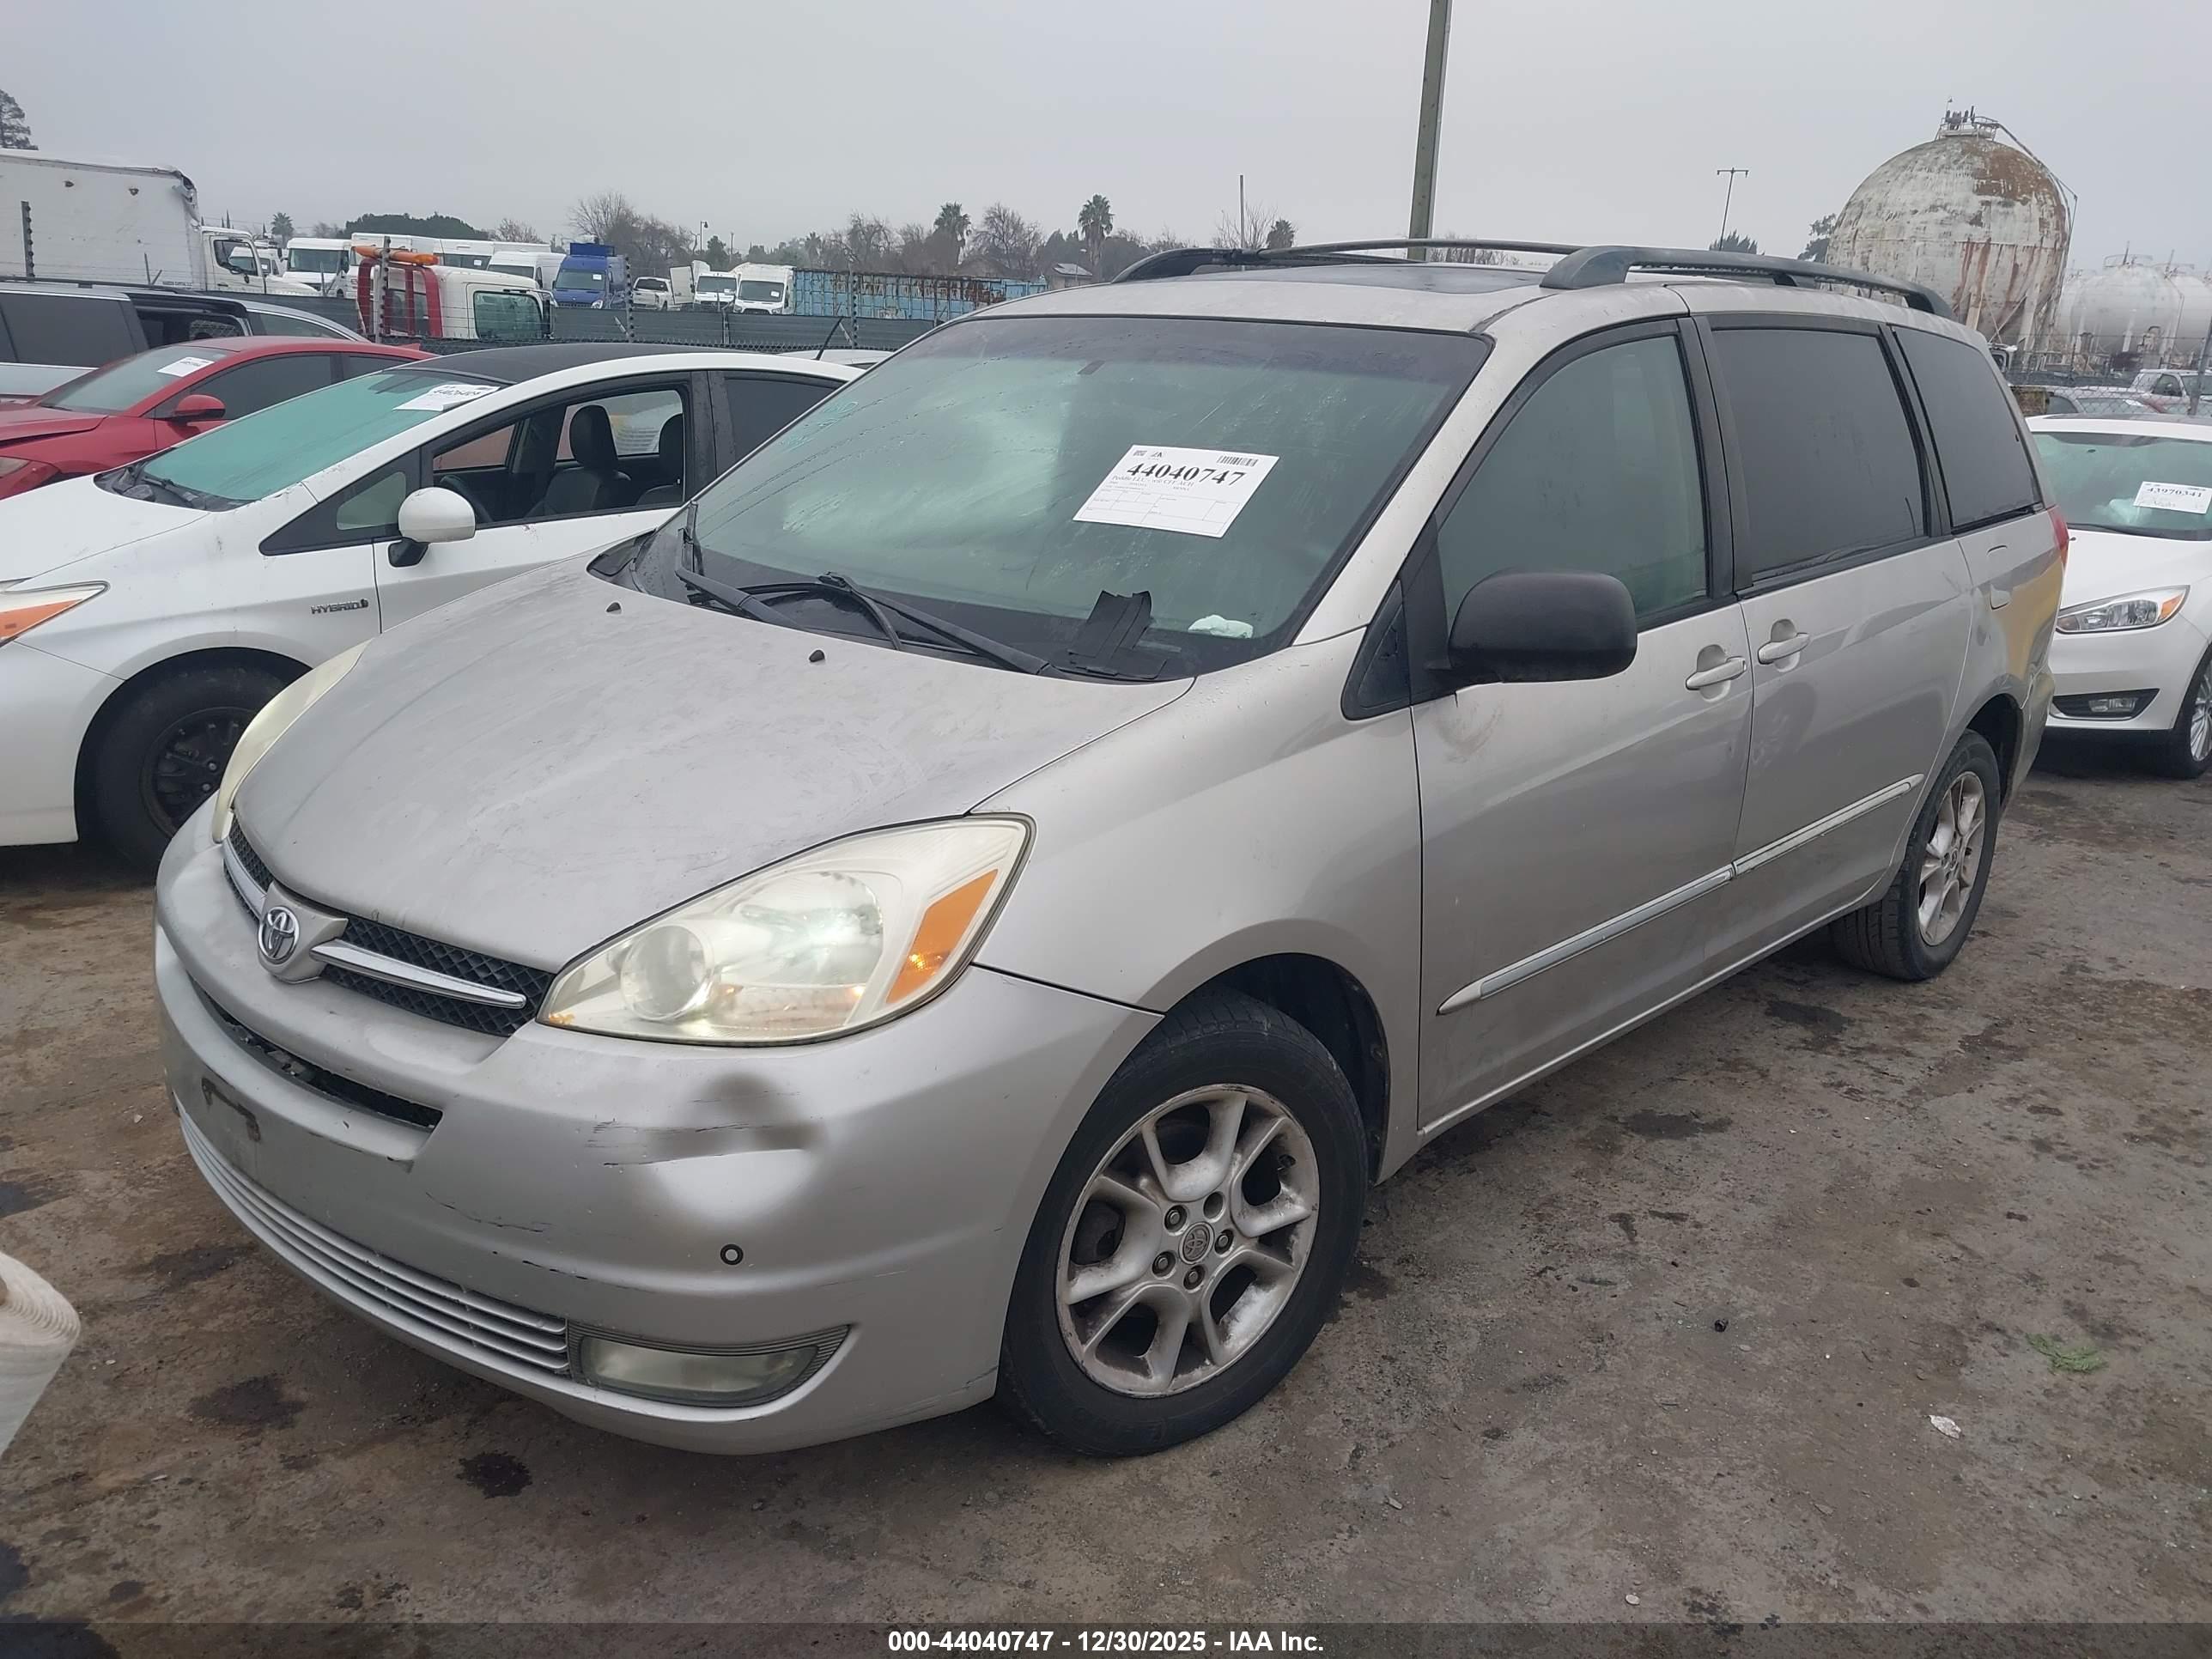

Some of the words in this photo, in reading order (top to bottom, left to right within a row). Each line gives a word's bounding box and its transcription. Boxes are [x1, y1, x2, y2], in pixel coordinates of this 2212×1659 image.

[1127, 463, 1247, 486] 44040747
[2147, 487, 2202, 497] 43970341
[310, 601, 360, 614] HYBRID
